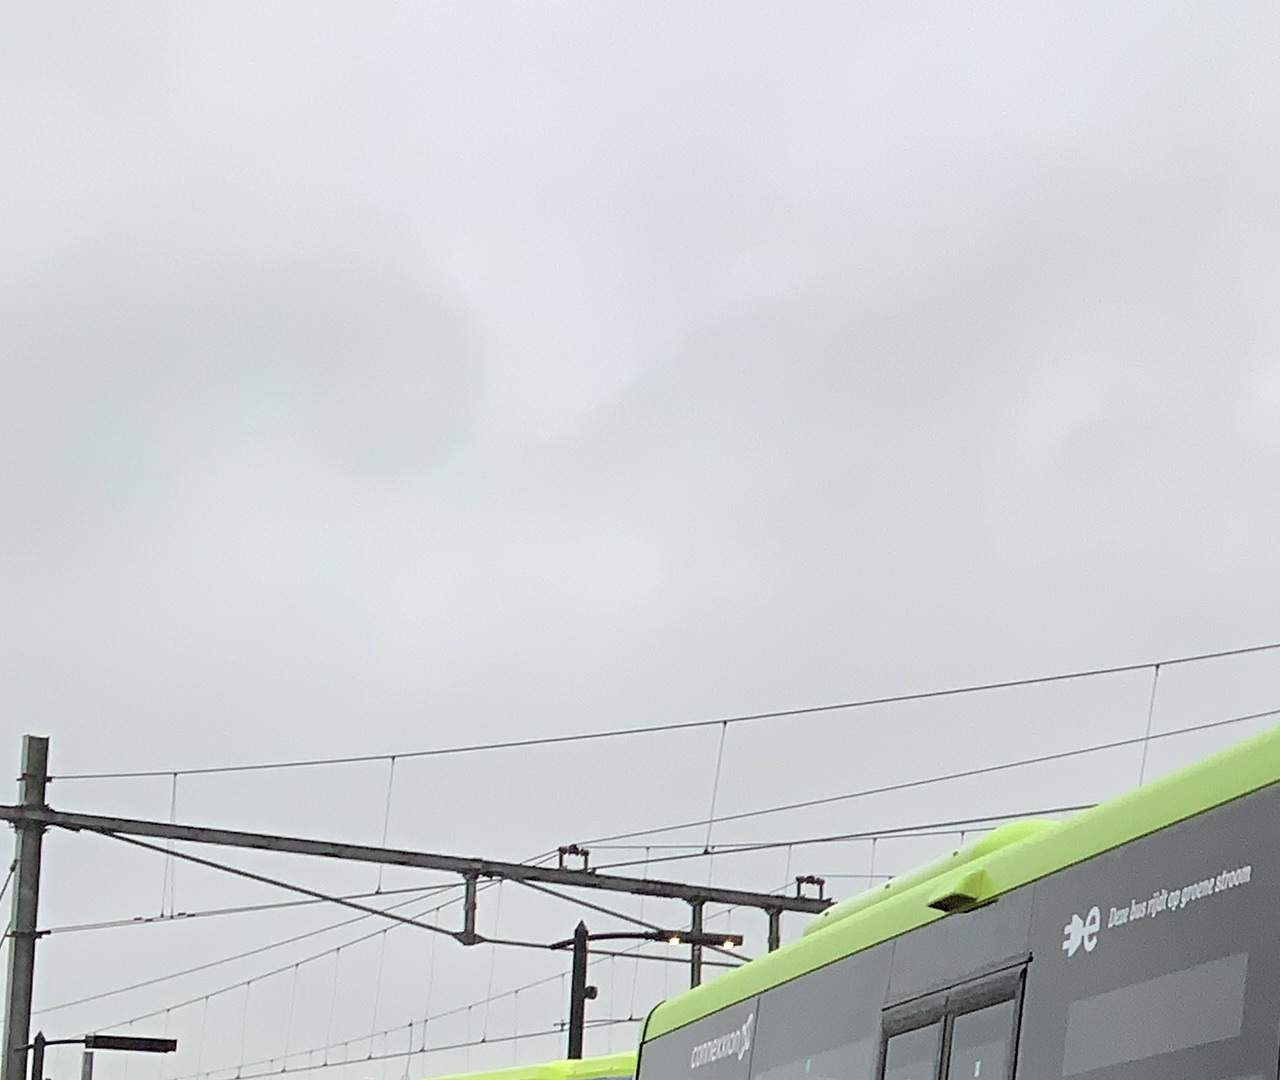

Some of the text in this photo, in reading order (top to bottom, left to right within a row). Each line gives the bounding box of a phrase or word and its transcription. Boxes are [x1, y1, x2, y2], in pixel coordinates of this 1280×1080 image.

[1130, 899, 1147, 921] bus
[1147, 889, 1168, 918] rijdt
[1168, 889, 1181, 911] op
[1180, 878, 1215, 908] groene
[1215, 865, 1251, 893] stroom
